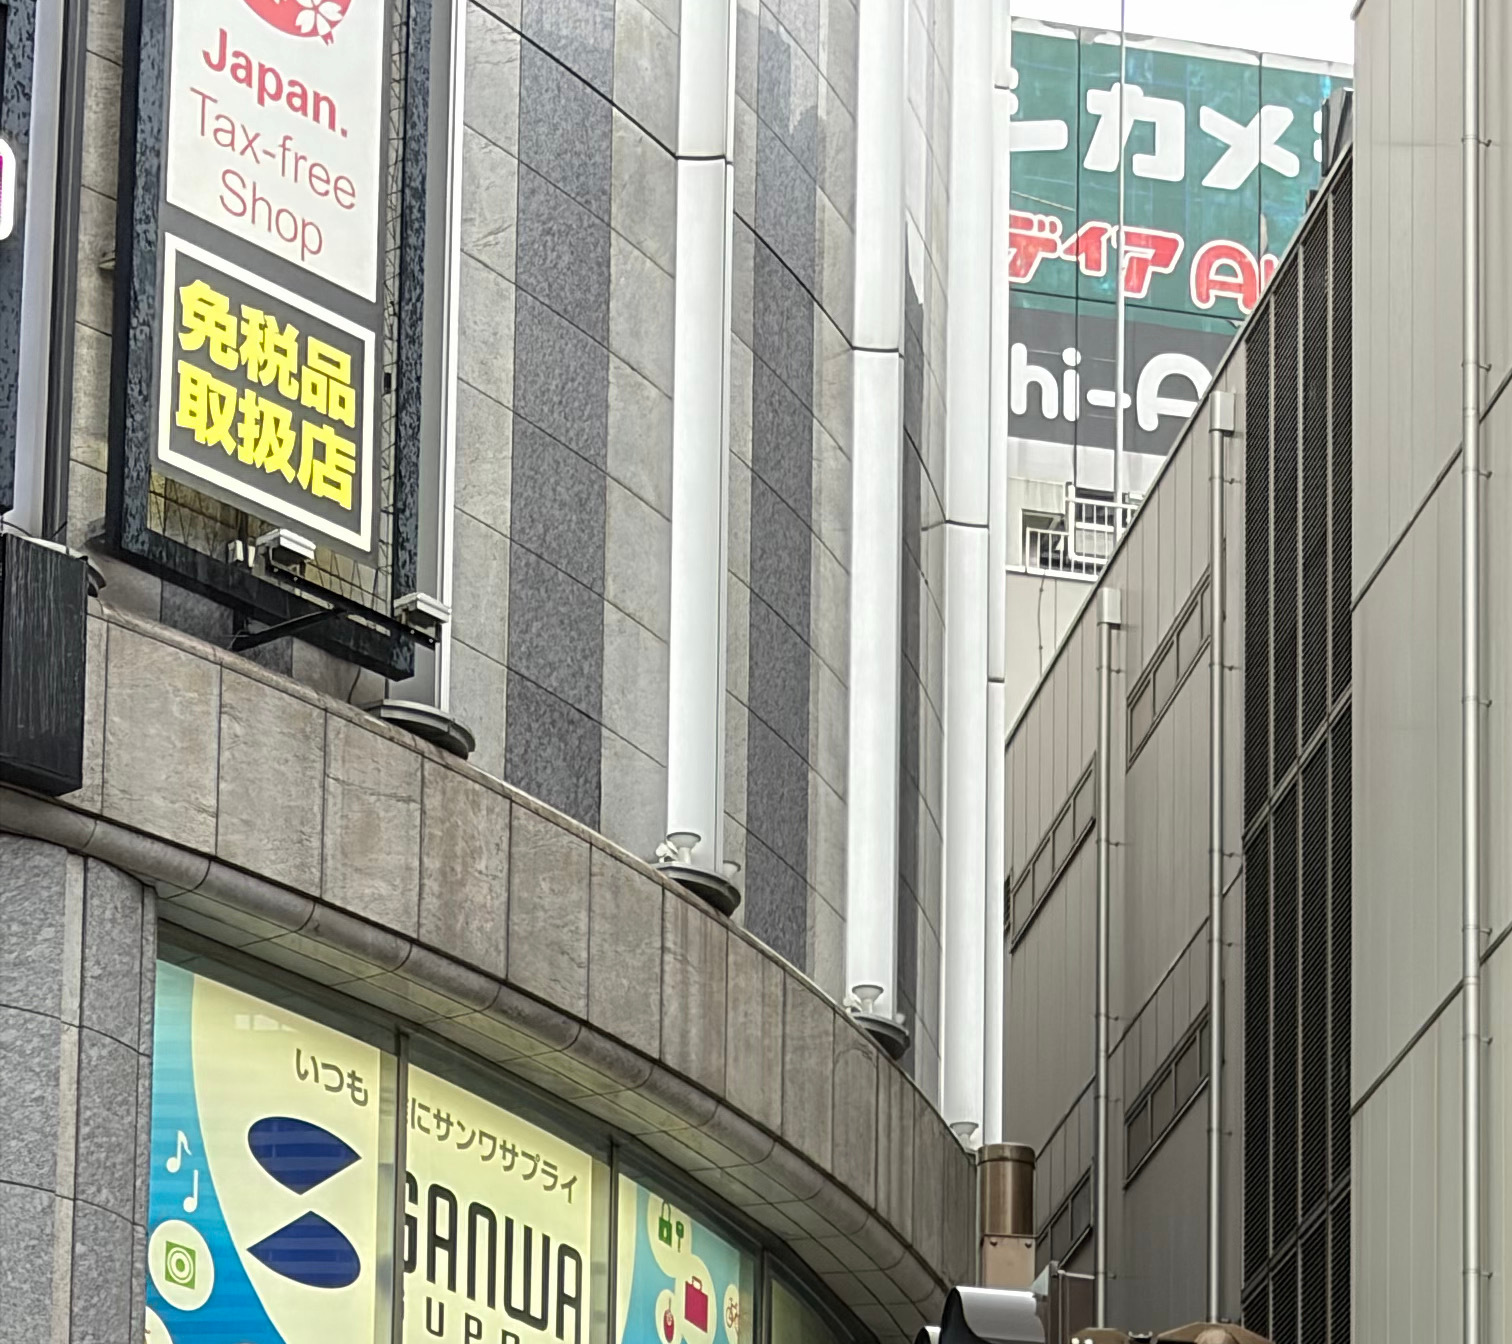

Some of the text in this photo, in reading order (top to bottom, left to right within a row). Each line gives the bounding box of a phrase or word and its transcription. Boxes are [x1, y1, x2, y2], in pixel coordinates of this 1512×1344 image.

[202, 28, 348, 138] Japan.
[1009, 67, 1322, 190] カメ
[190, 88, 357, 211] Tax-free
[220, 168, 323, 262] Shop
[1190, 239, 1282, 315] A
[178, 279, 356, 429] 免税品
[175, 360, 356, 511] 取扱店
[295, 1047, 578, 1204] いつもにサンワサプライ
